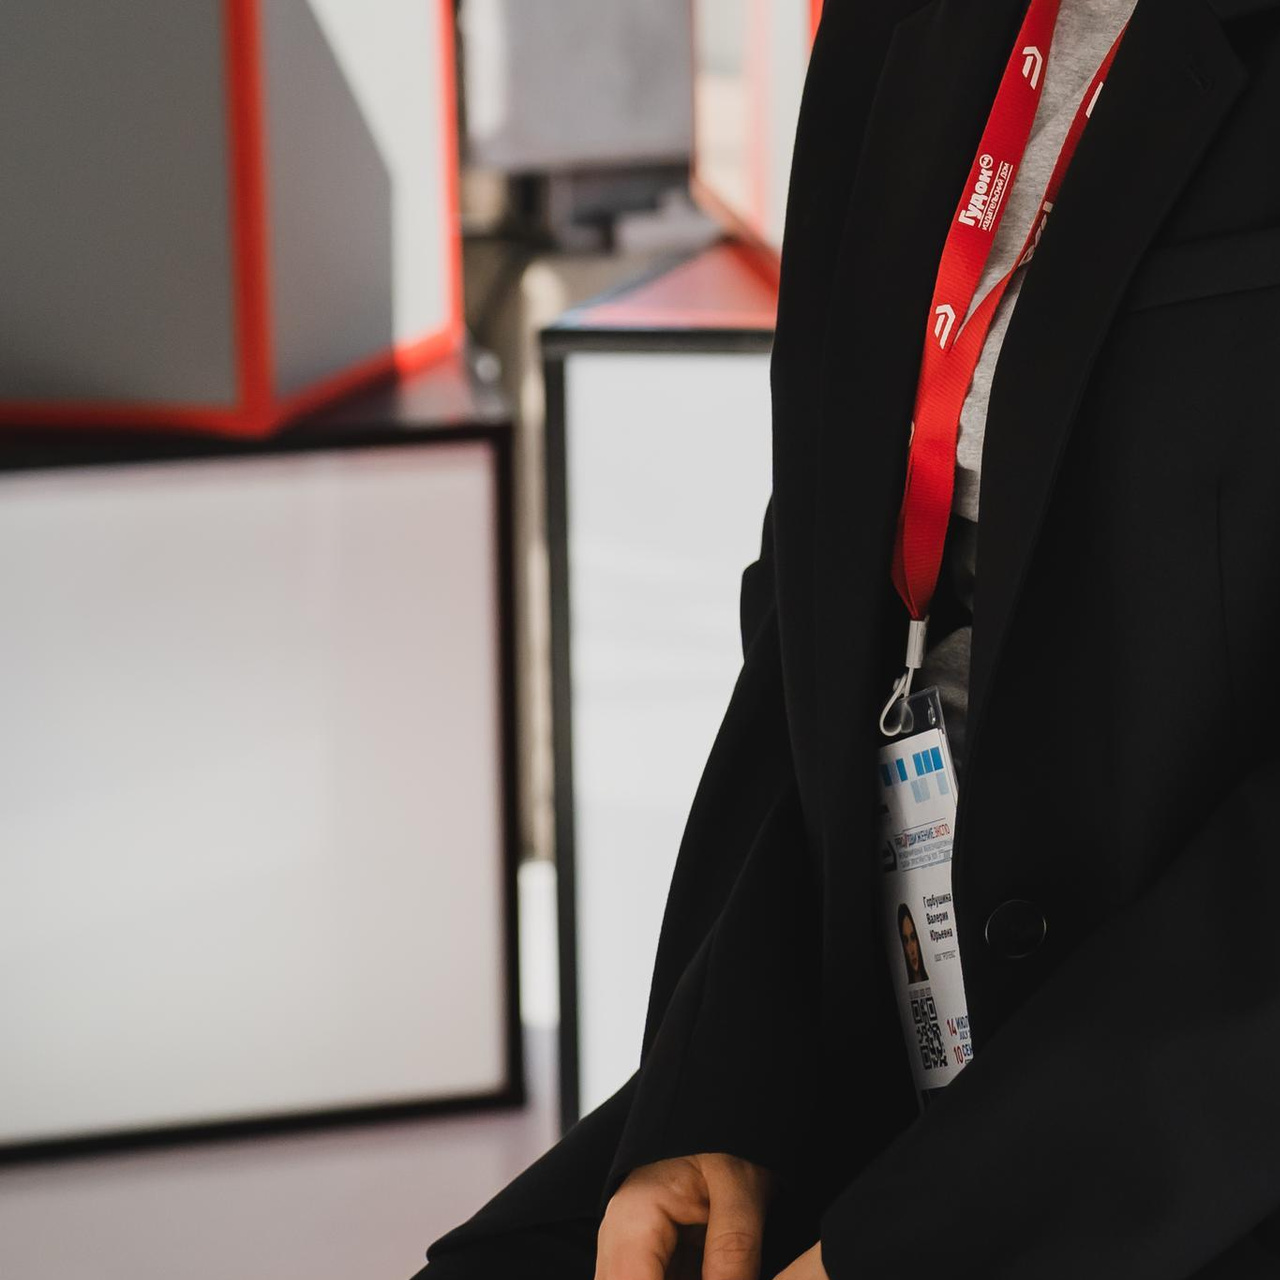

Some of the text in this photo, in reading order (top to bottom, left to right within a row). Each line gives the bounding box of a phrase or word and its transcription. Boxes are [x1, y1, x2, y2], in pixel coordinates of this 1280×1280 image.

[958, 168, 993, 226] Гудок
[982, 179, 1005, 231] издательский
[1000, 162, 1010, 179] дом
[922, 893, 952, 910] Горбушина
[926, 911, 949, 925] Валерия
[930, 928, 953, 943] Юрьевна
[946, 1018, 957, 1036] 14
[954, 1045, 964, 1064] 10
